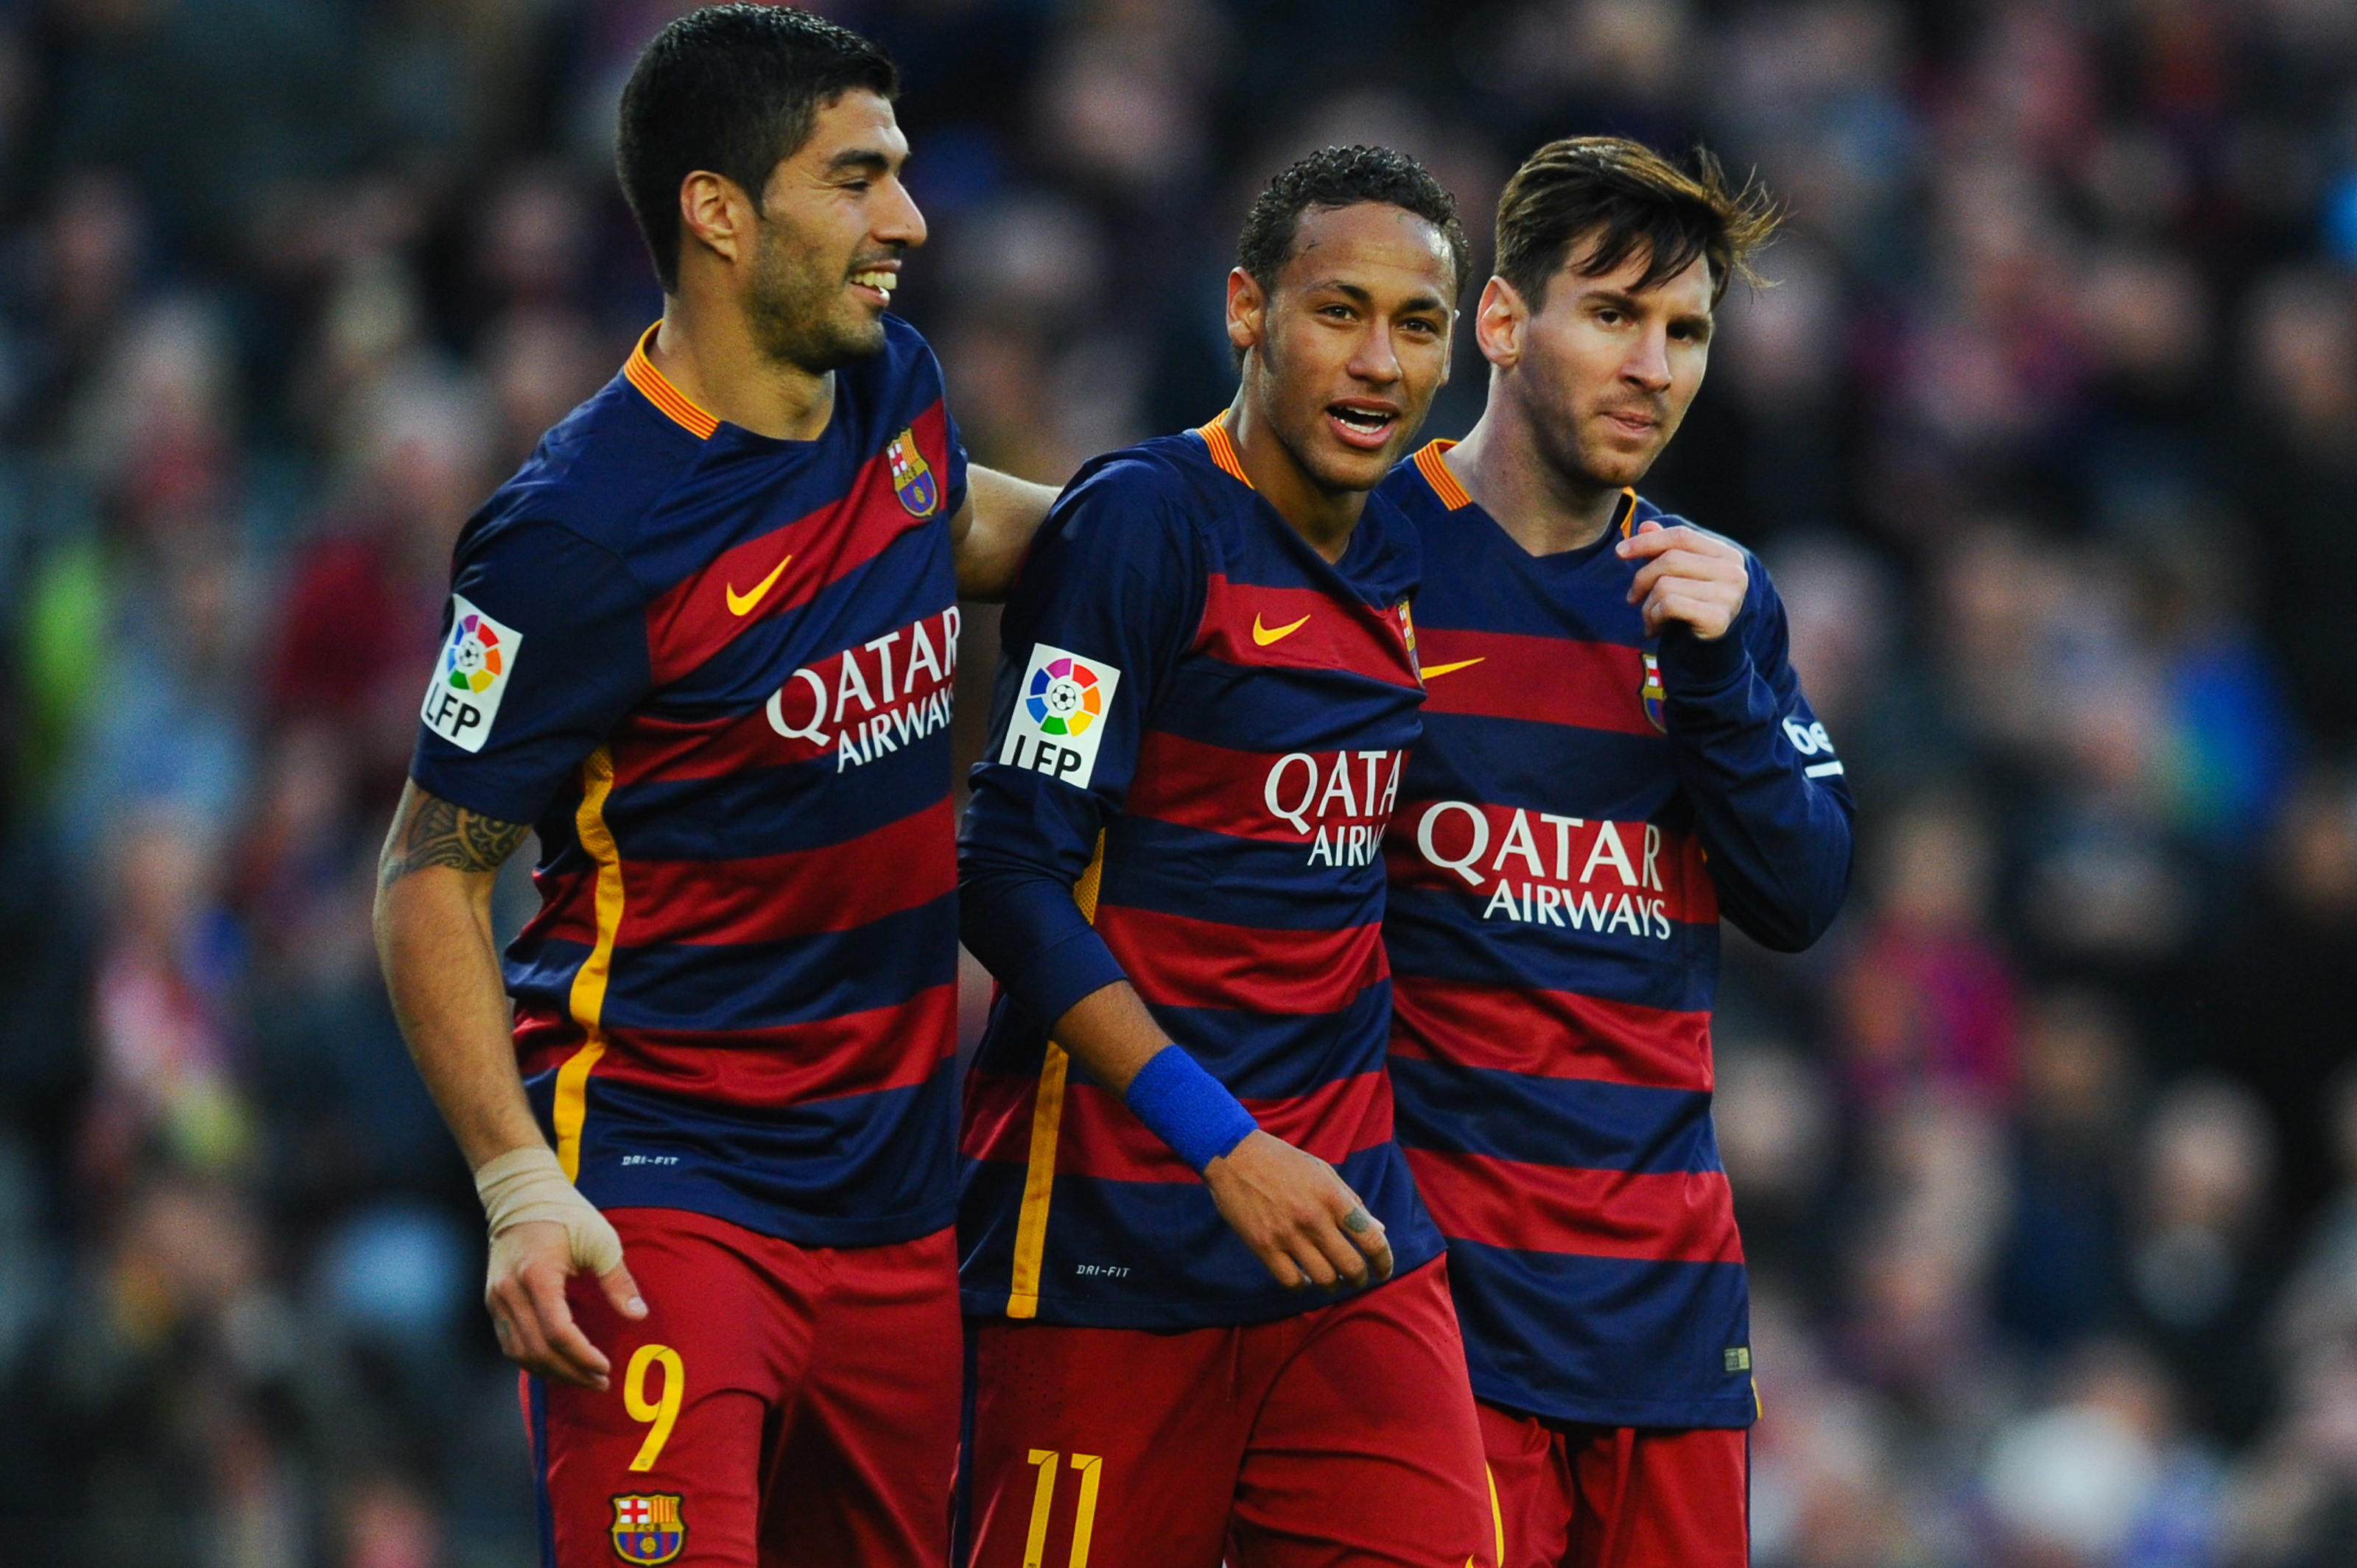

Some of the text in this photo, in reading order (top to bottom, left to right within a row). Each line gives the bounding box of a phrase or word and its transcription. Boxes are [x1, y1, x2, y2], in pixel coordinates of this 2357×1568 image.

[426, 682, 481, 737] LFP
[766, 605, 960, 746] QATAR
[837, 683, 954, 773] AIRWAY
[1782, 717, 1834, 755] be
[1265, 750, 1402, 835] QATA
[1307, 823, 1386, 866] AIRW
[1417, 801, 1663, 892] QATAR
[1483, 879, 1671, 941] AIRWAYS
[621, 1155, 679, 1165] DRI-FIT
[1076, 1265, 1130, 1277] DRI-FIT
[624, 1343, 684, 1472] 9
[1022, 1449, 1103, 1568] 11
